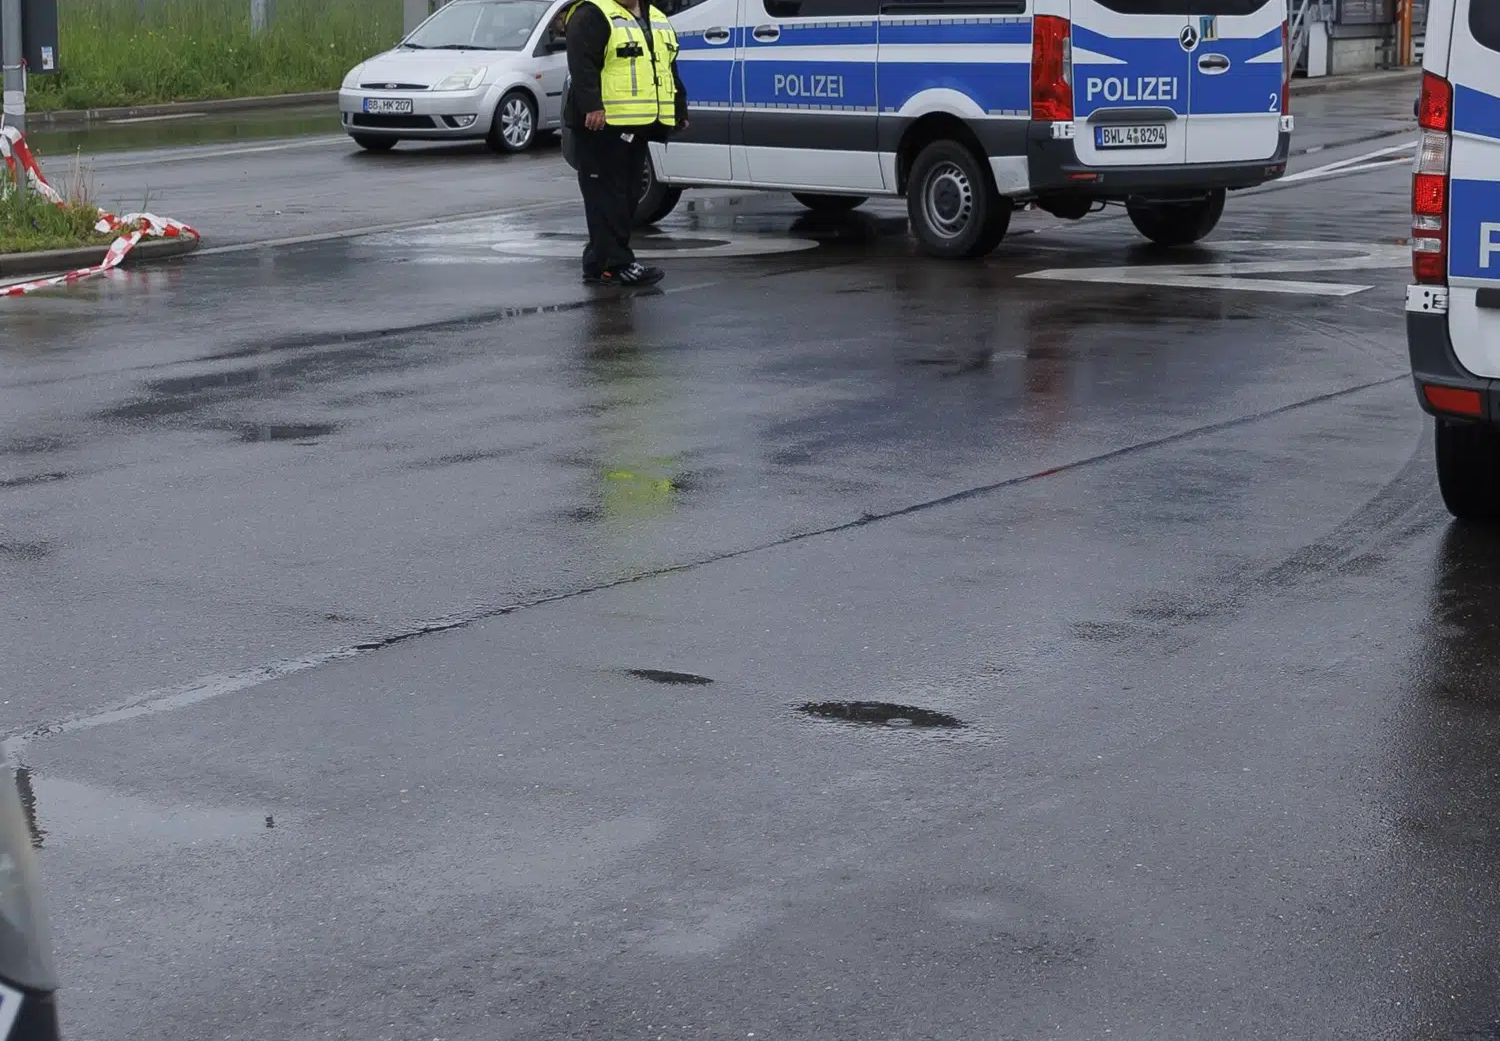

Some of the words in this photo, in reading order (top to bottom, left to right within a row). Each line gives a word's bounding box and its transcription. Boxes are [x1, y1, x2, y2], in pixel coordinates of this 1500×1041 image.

[773, 74, 844, 98] POLIZEI
[1086, 76, 1178, 101] POLIZEI
[395, 100, 411, 111] 207
[1268, 92, 1278, 112] 2
[1103, 128, 1124, 144] BWL
[1126, 128, 1133, 144] 4
[1140, 127, 1165, 143] 8294
